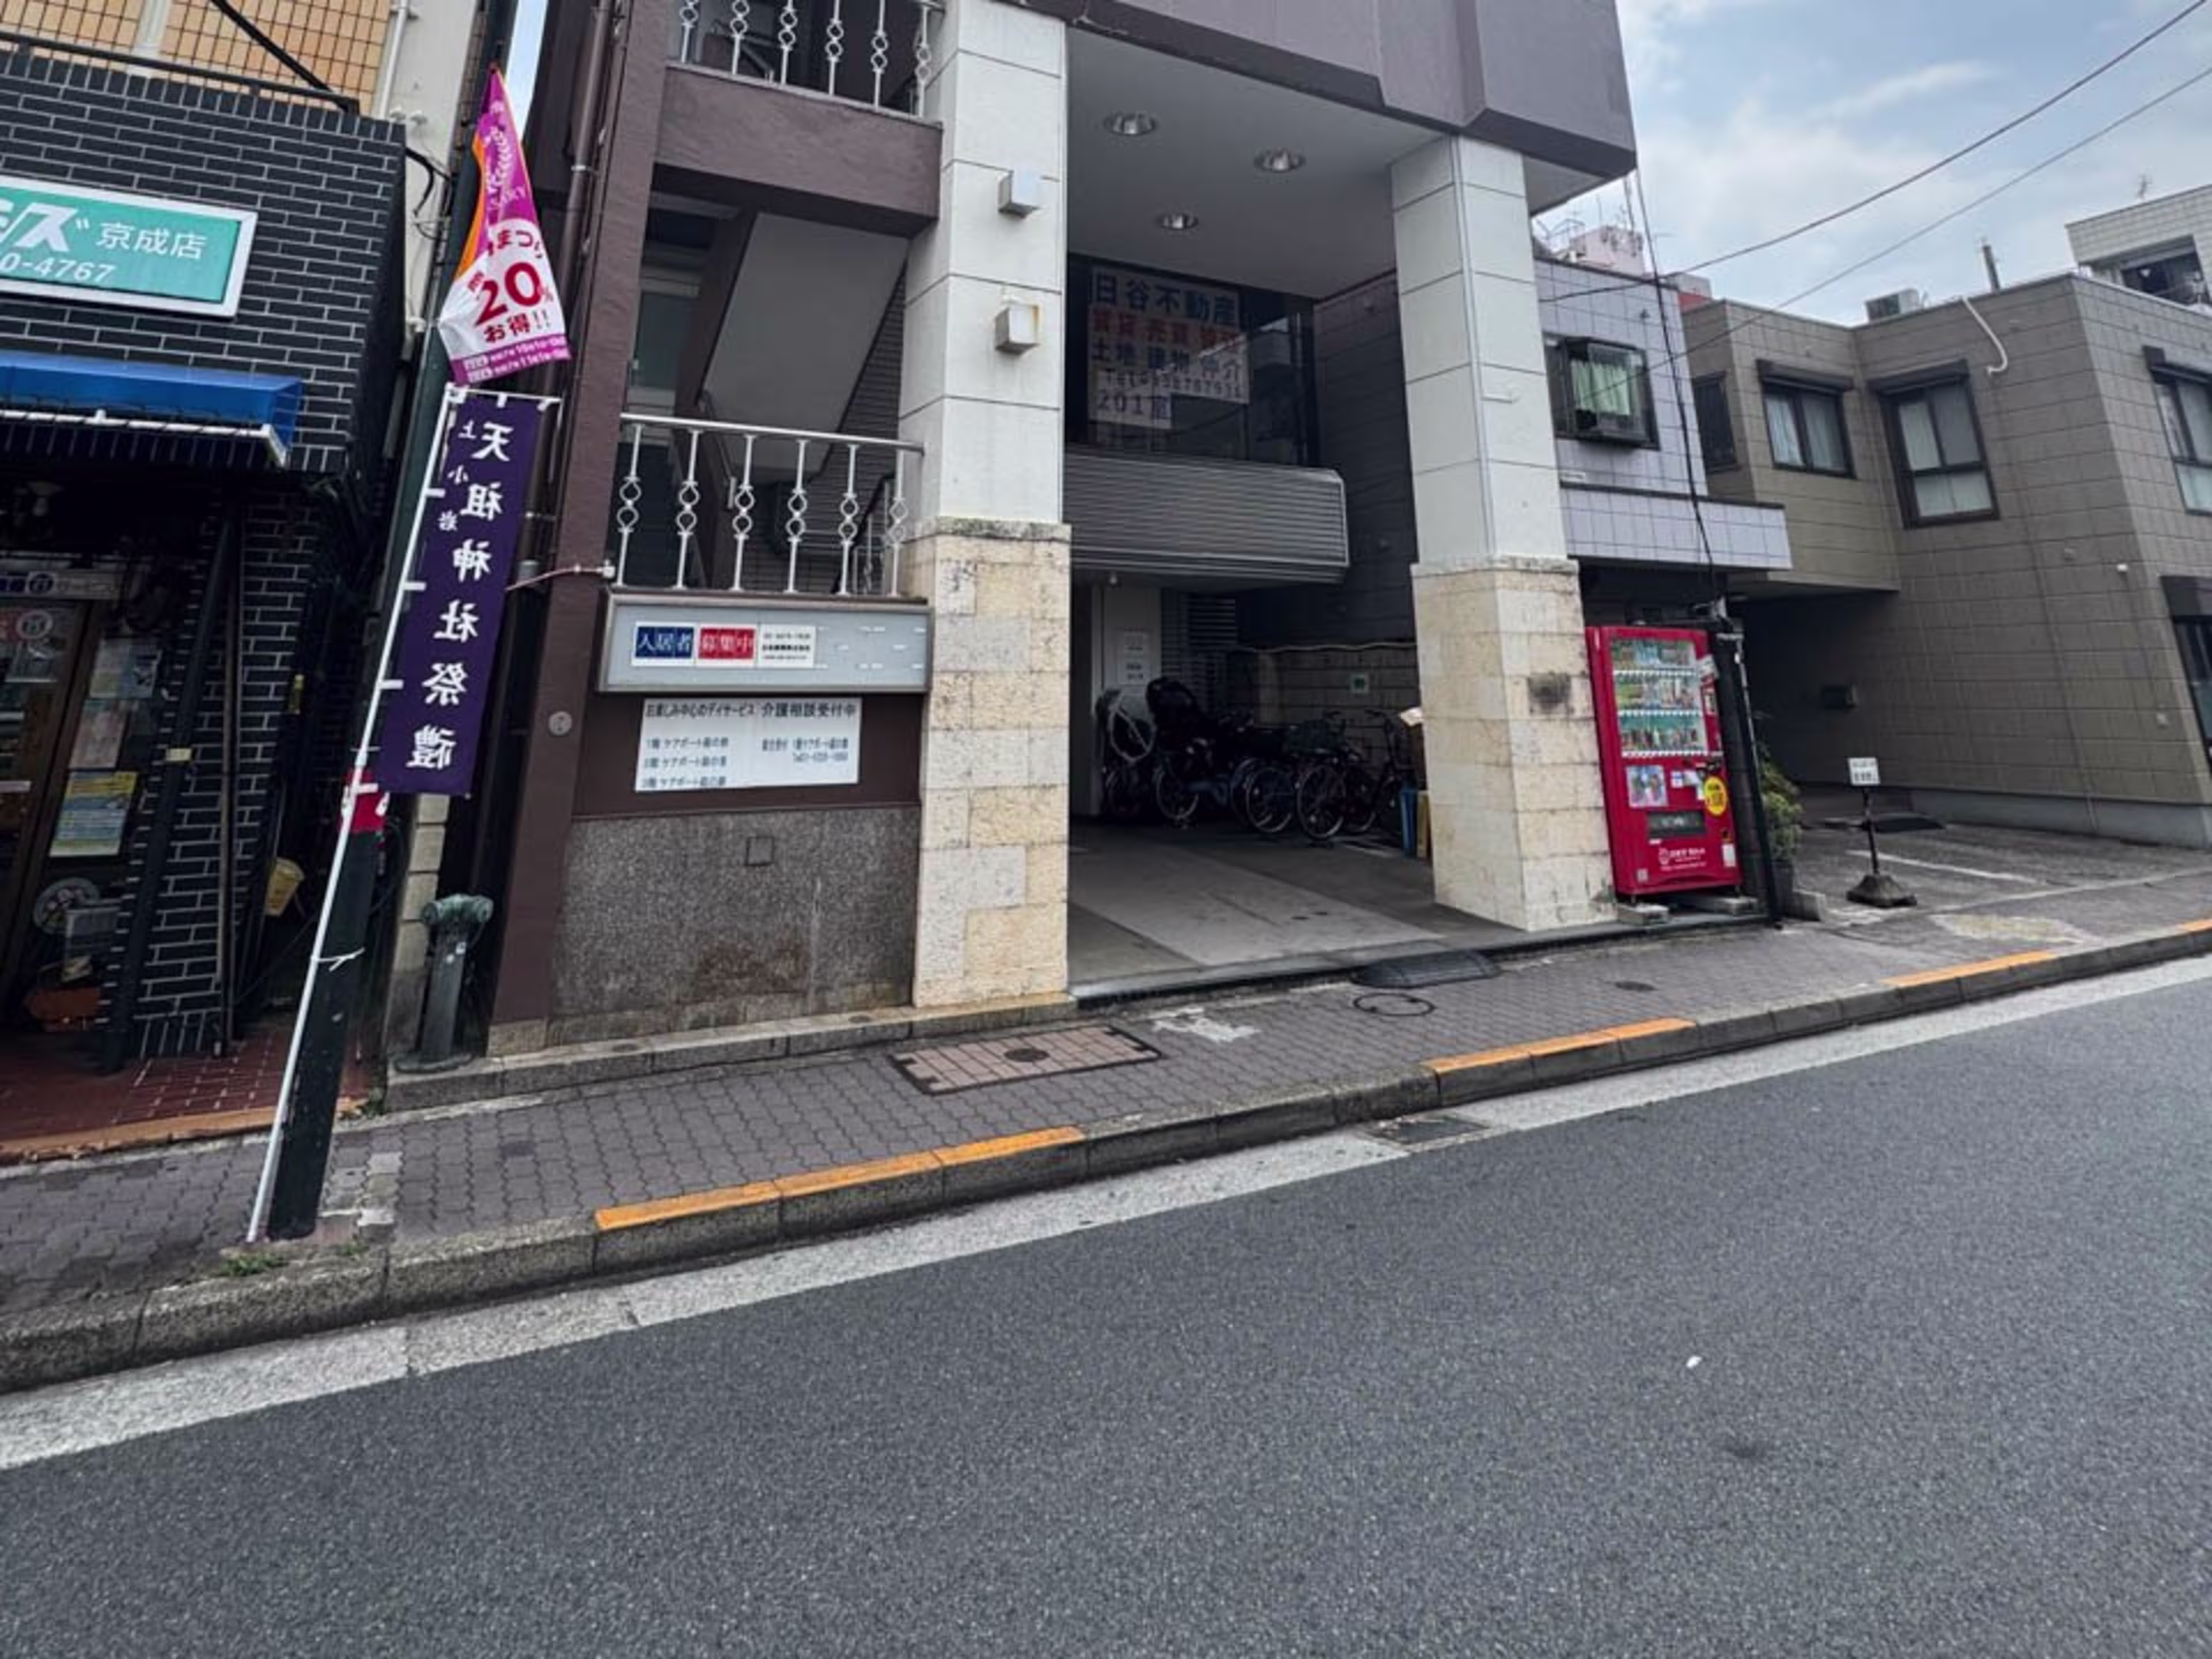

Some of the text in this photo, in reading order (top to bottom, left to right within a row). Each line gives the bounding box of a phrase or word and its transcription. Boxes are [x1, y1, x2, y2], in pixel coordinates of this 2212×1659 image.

[96, 221, 207, 260] 京成店
[638, 632, 692, 652] 入居者
